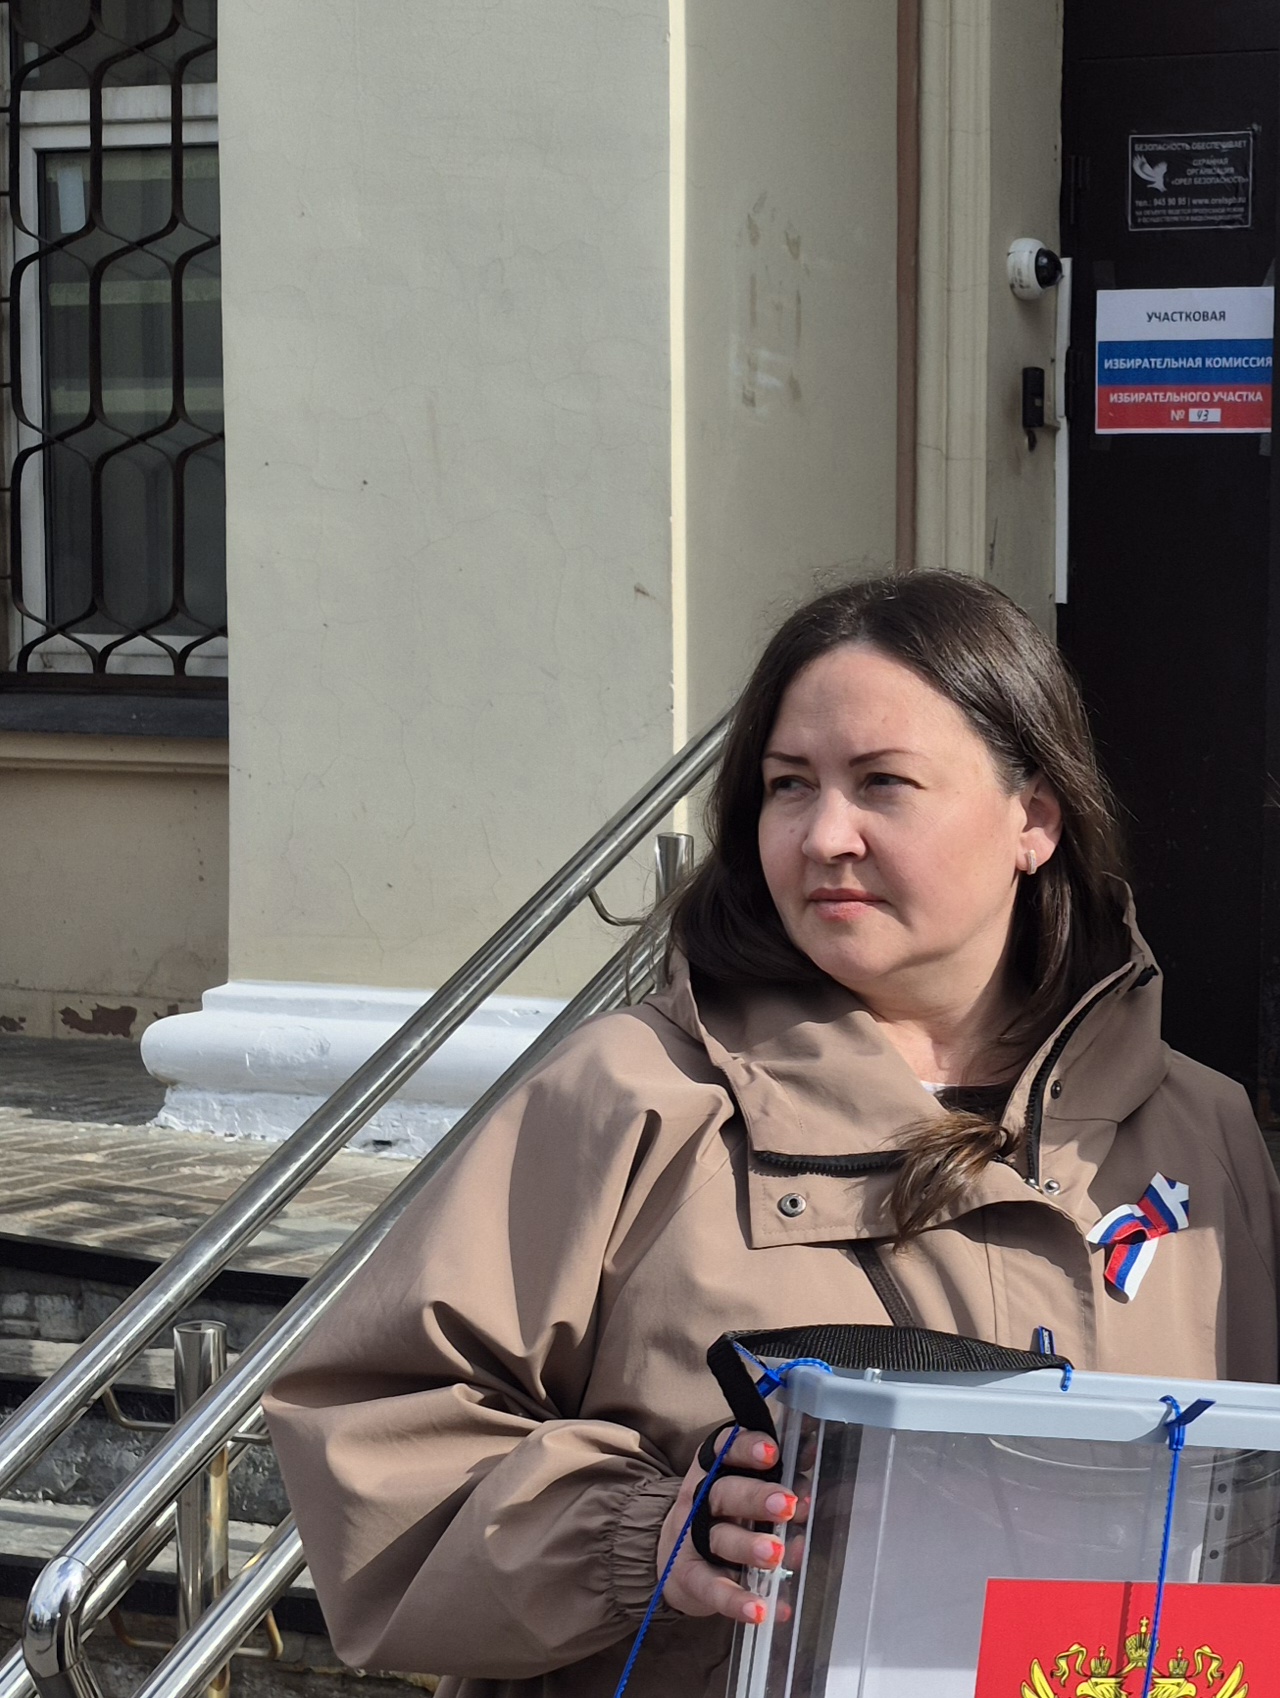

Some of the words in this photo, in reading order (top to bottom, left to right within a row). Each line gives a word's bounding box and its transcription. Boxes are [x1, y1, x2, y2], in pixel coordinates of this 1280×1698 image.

[1146, 310, 1226, 323] УЧАСТКОВАЯ
[1104, 357, 1203, 370] ИЗБИРАТЕЛЬНАЯ
[1205, 356, 1273, 368] КОМИССИЯ
[1109, 391, 1211, 403] ИЗБИРАТЕЛЬНОГО
[1212, 391, 1263, 403] УЧАСТКА
[1171, 409, 1185, 421] №
